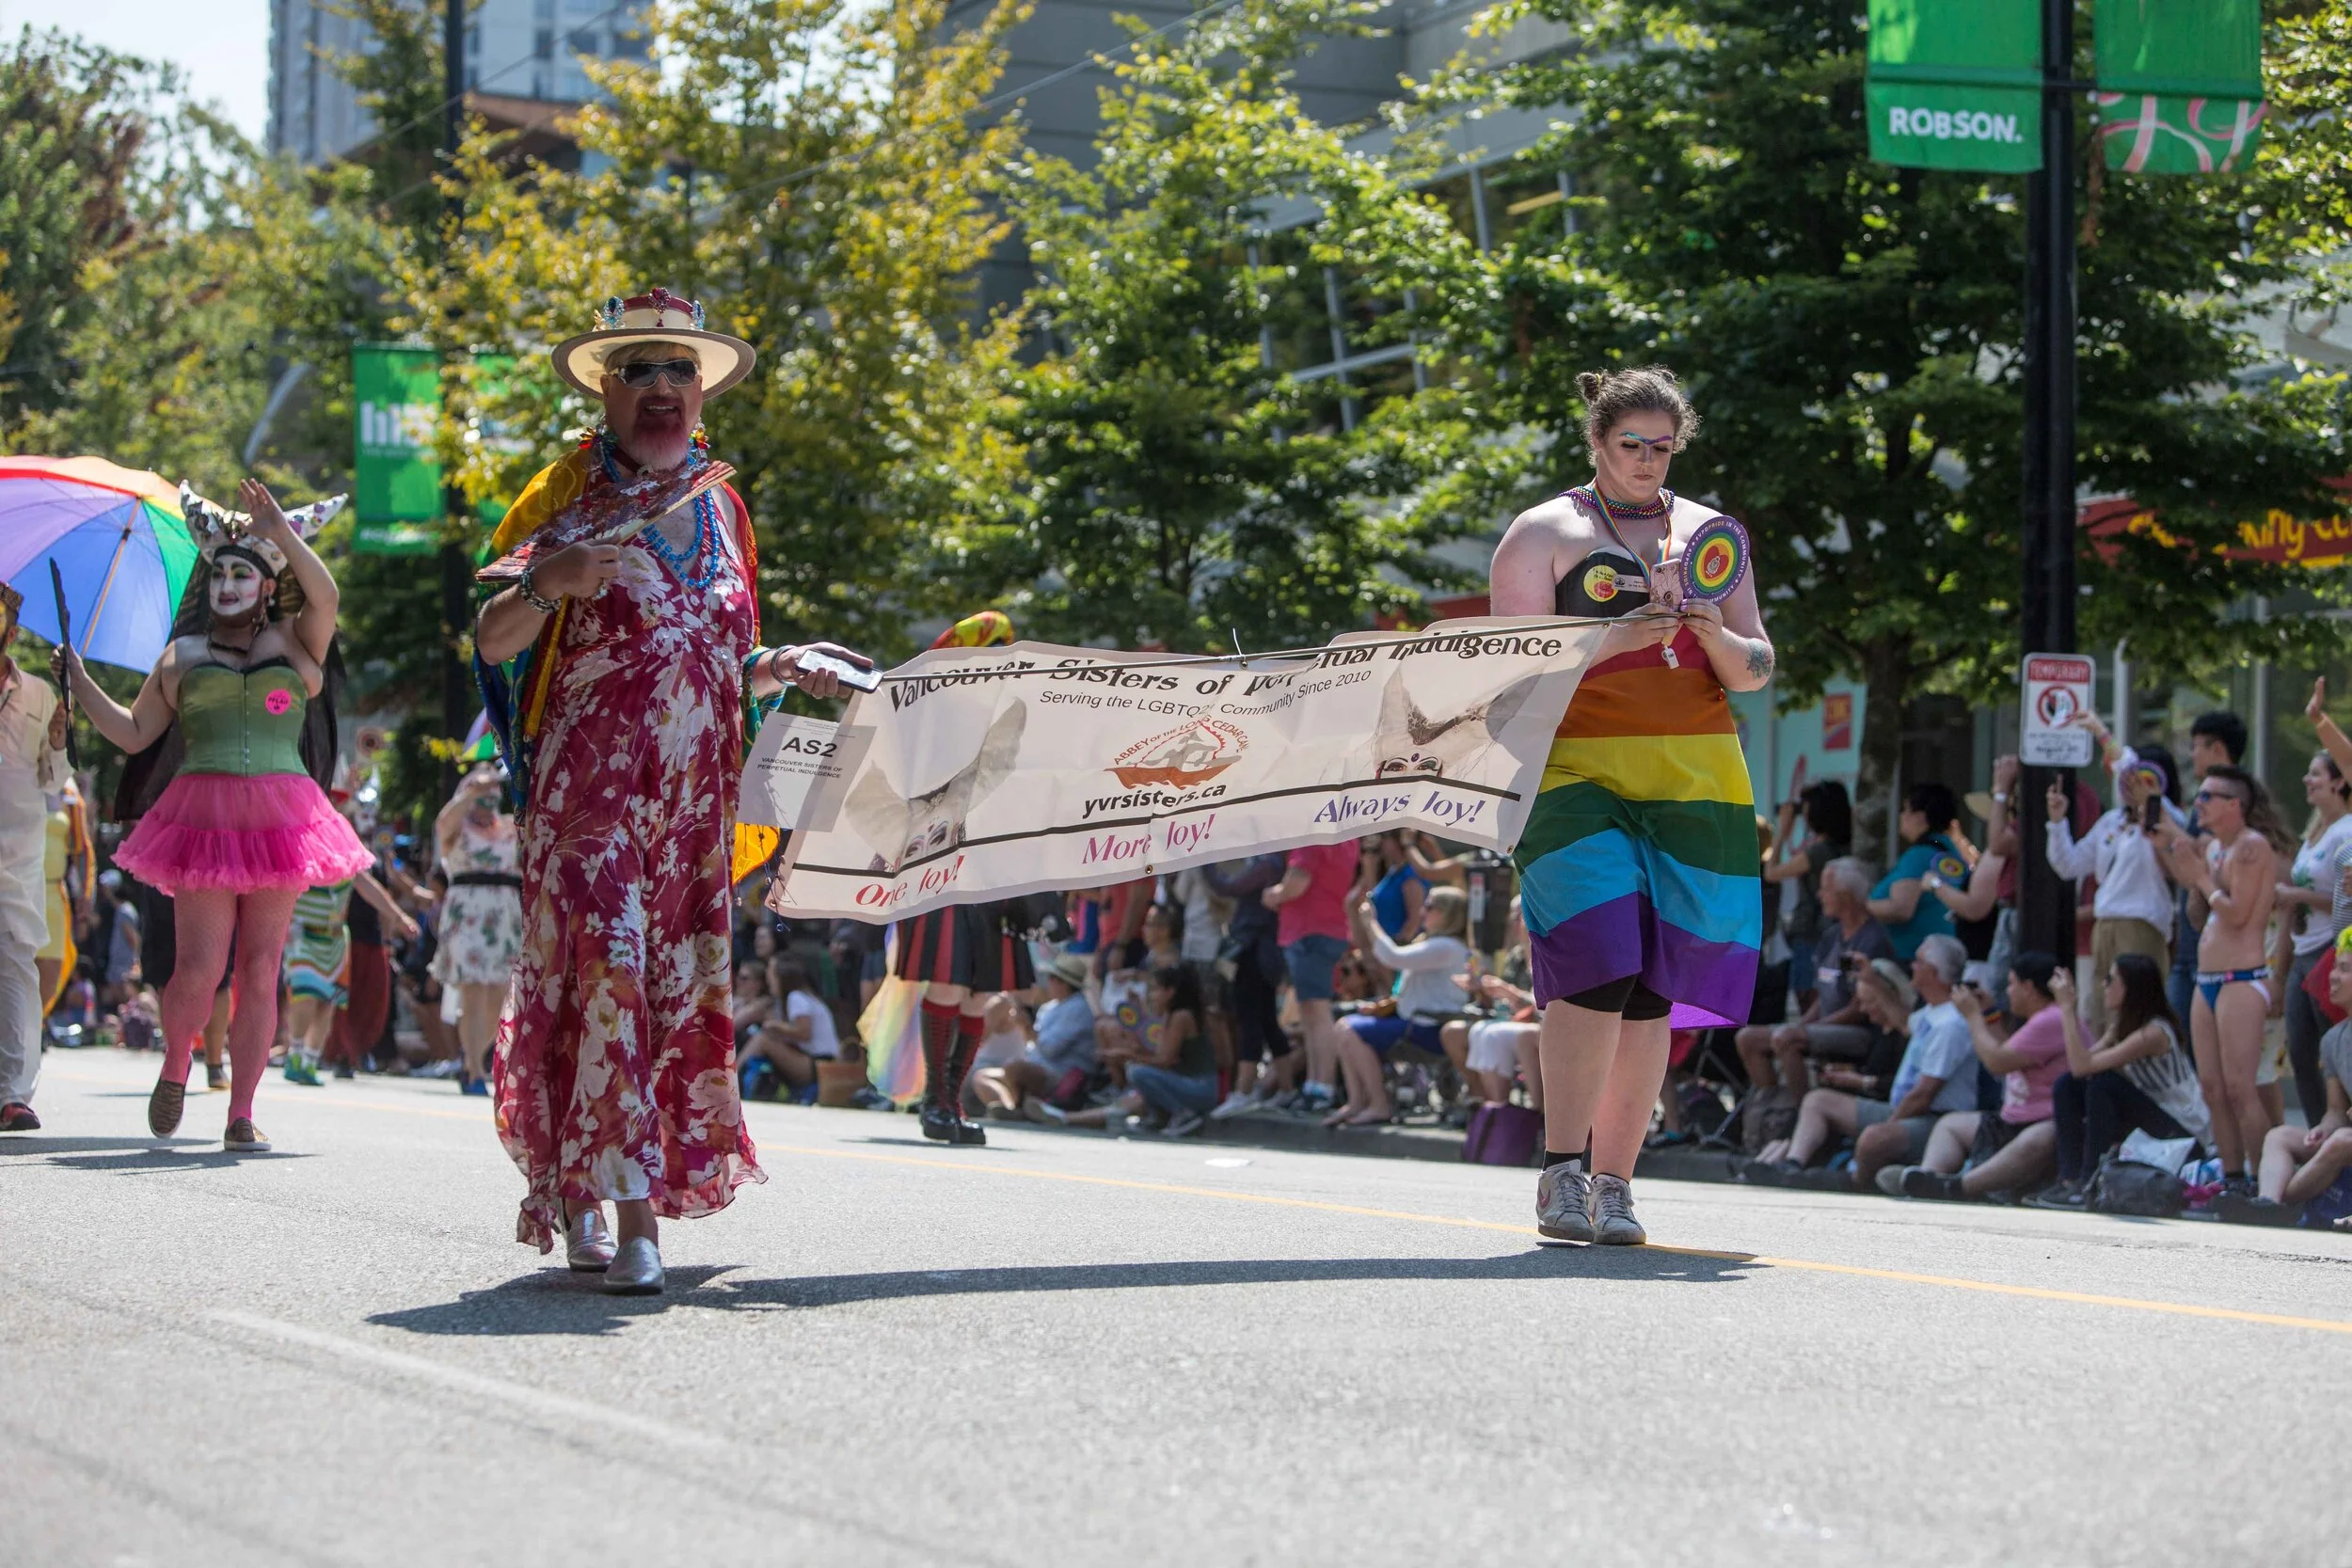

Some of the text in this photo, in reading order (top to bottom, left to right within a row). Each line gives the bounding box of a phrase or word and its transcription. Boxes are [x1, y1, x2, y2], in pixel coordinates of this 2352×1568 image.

[1888, 106, 2023, 143] ROBSON.
[1733, 525, 1741, 535] THE
[1049, 658, 1179, 691] Sisters
[1196, 673, 1235, 695] of
[1040, 690, 1103, 708] Serving
[1106, 695, 1133, 708] the
[1220, 691, 1295, 717] Community
[1298, 679, 1332, 699] Since
[1335, 670, 1372, 688] 2010
[782, 736, 837, 757] AS2
[1114, 737, 1150, 766] ABBEY
[1150, 734, 1162, 742] OF
[1163, 728, 1177, 737] THE
[1212, 720, 1244, 738] CEDAR
[757, 764, 841, 779] PERPETUAL INDULGENCE
[761, 757, 803, 767] VANCOUVER
[803, 763, 833, 771] SISTERS
[1083, 784, 1227, 819] yvrsisters.ca
[1313, 794, 1411, 823] Always
[1082, 834, 1152, 864] More
[855, 882, 908, 908] One
